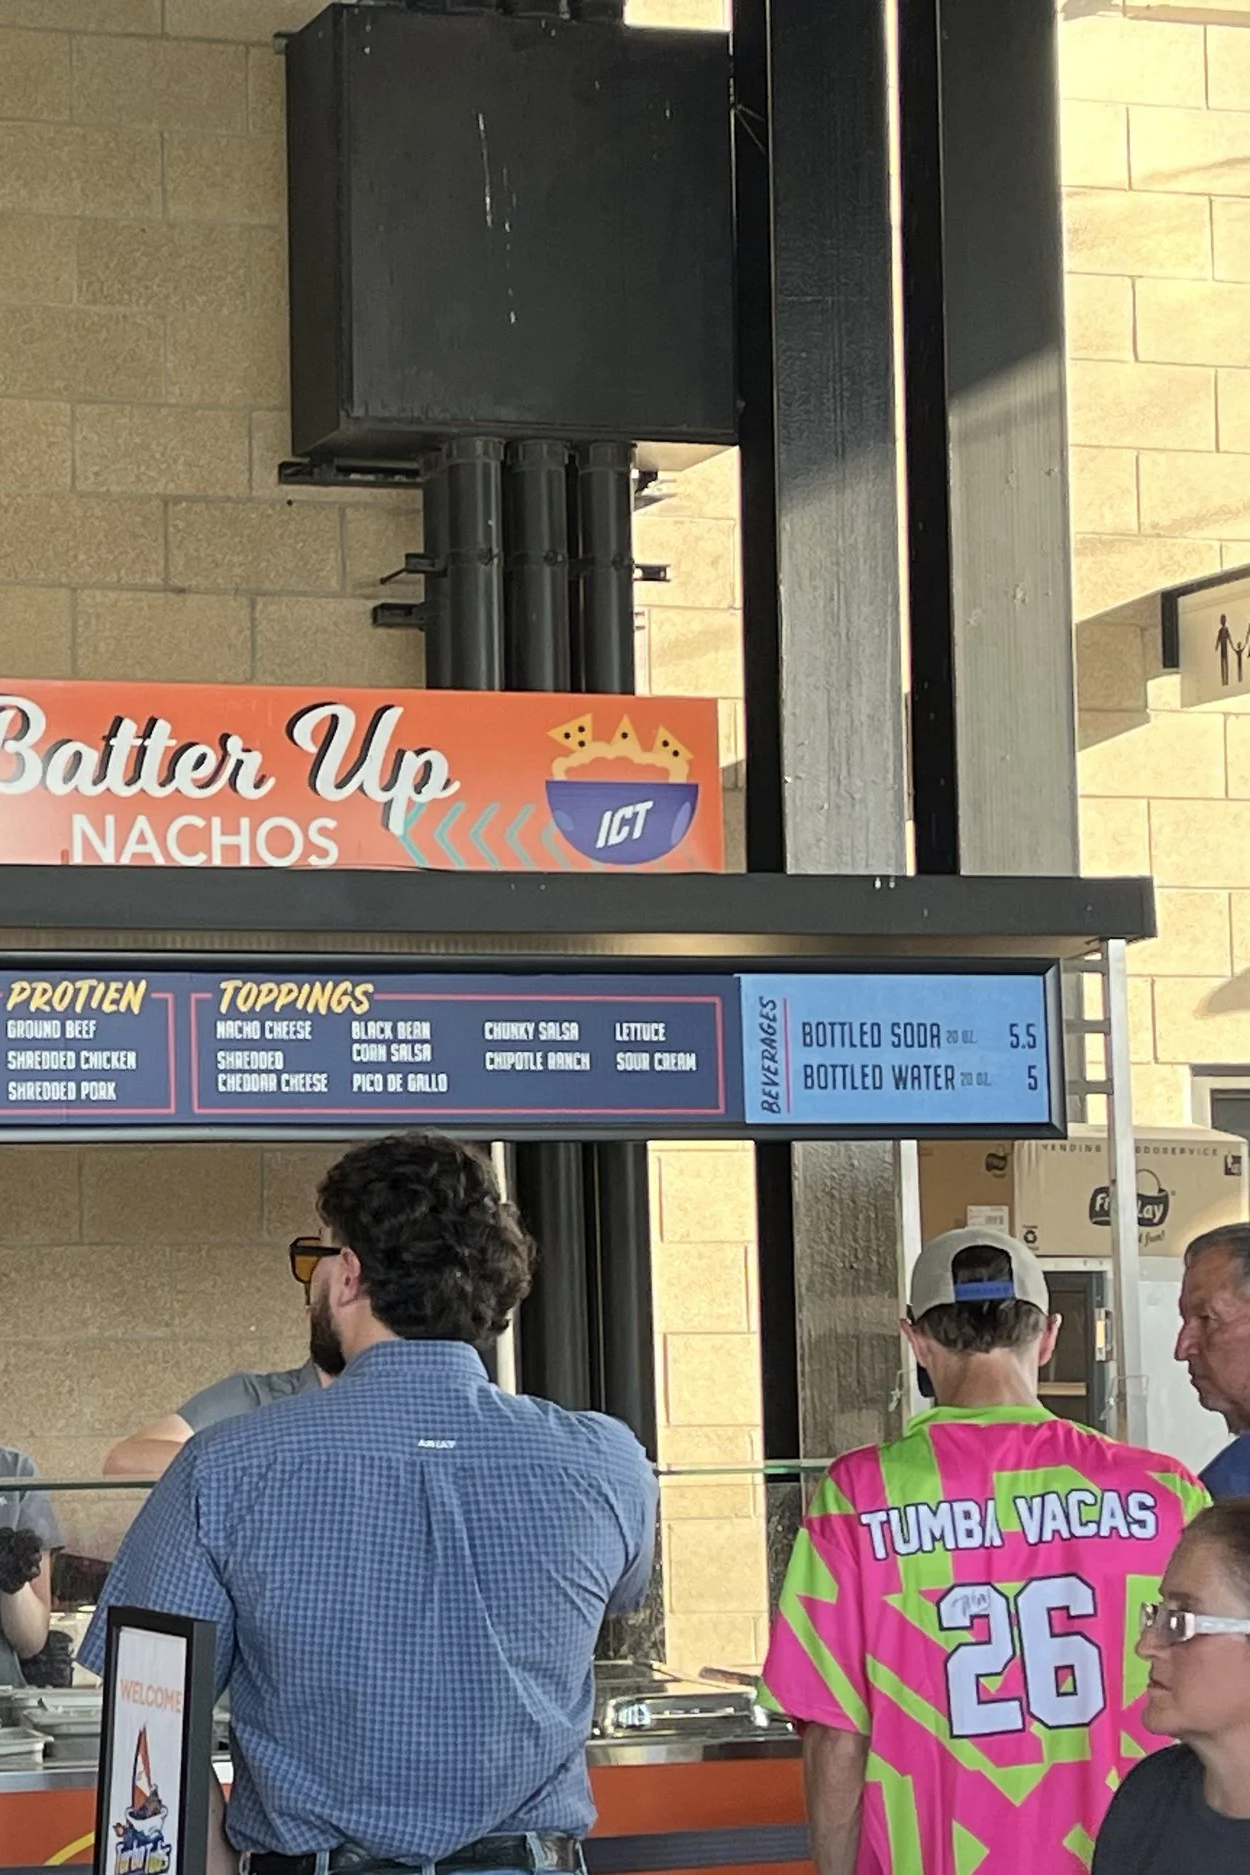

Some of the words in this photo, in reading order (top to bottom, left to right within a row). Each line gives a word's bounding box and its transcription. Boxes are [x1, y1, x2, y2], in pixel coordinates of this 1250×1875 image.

[287, 701, 461, 836] Up
[595, 799, 653, 849] ICT
[71, 812, 338, 868] NACHOS
[6, 978, 147, 1015] PROTIEN
[219, 979, 375, 1015] TOPPINGS
[6, 1019, 61, 1039] GROUND
[65, 1019, 97, 1039] BEEF
[216, 1020, 261, 1040] NACHO
[264, 1020, 312, 1040] CHEESE
[351, 1020, 393, 1040] BLACK
[396, 1020, 431, 1040] BEAN
[484, 1021, 535, 1040] CHUNKY
[538, 1021, 579, 1040] SALSA
[615, 1022, 666, 1041] LETTUCE
[802, 1021, 882, 1049] BOTTLED
[890, 1021, 942, 1049] SODA
[945, 1029, 959, 1044] 20
[1009, 1023, 1037, 1049] 5.5
[7, 1050, 76, 1070] SHREDDED
[80, 1050, 137, 1070] CHICKEN
[217, 1050, 284, 1070] SHREDDED
[352, 1043, 387, 1063] CORN
[390, 1043, 432, 1063] SALSA
[485, 1051, 544, 1071] CHIPOTLE
[547, 1051, 590, 1071] RANCH
[616, 1052, 650, 1071] SOUR
[654, 1052, 697, 1071] CREAM
[758, 995, 782, 1115] BEVERAGES
[217, 1073, 277, 1092] CHEDDAR
[280, 1073, 328, 1092] CHEESE
[352, 1073, 383, 1092] PICO
[386, 1073, 403, 1092] DE
[407, 1073, 448, 1092] GALLO
[803, 1064, 883, 1091] BOTTLED
[892, 1064, 956, 1091] WATER
[959, 1072, 973, 1087] 20
[1027, 1064, 1038, 1092] 5
[8, 1081, 77, 1100] SHREDDED
[80, 1081, 117, 1100] PORK
[1043, 1143, 1102, 1153] VENDING
[1135, 1145, 1218, 1157] OODSERVICE
[860, 1499, 1004, 1561] TUMBA
[1014, 1489, 1158, 1545] VACAS
[937, 1572, 1107, 1739] 26
[119, 1678, 183, 1714] WELCOME
